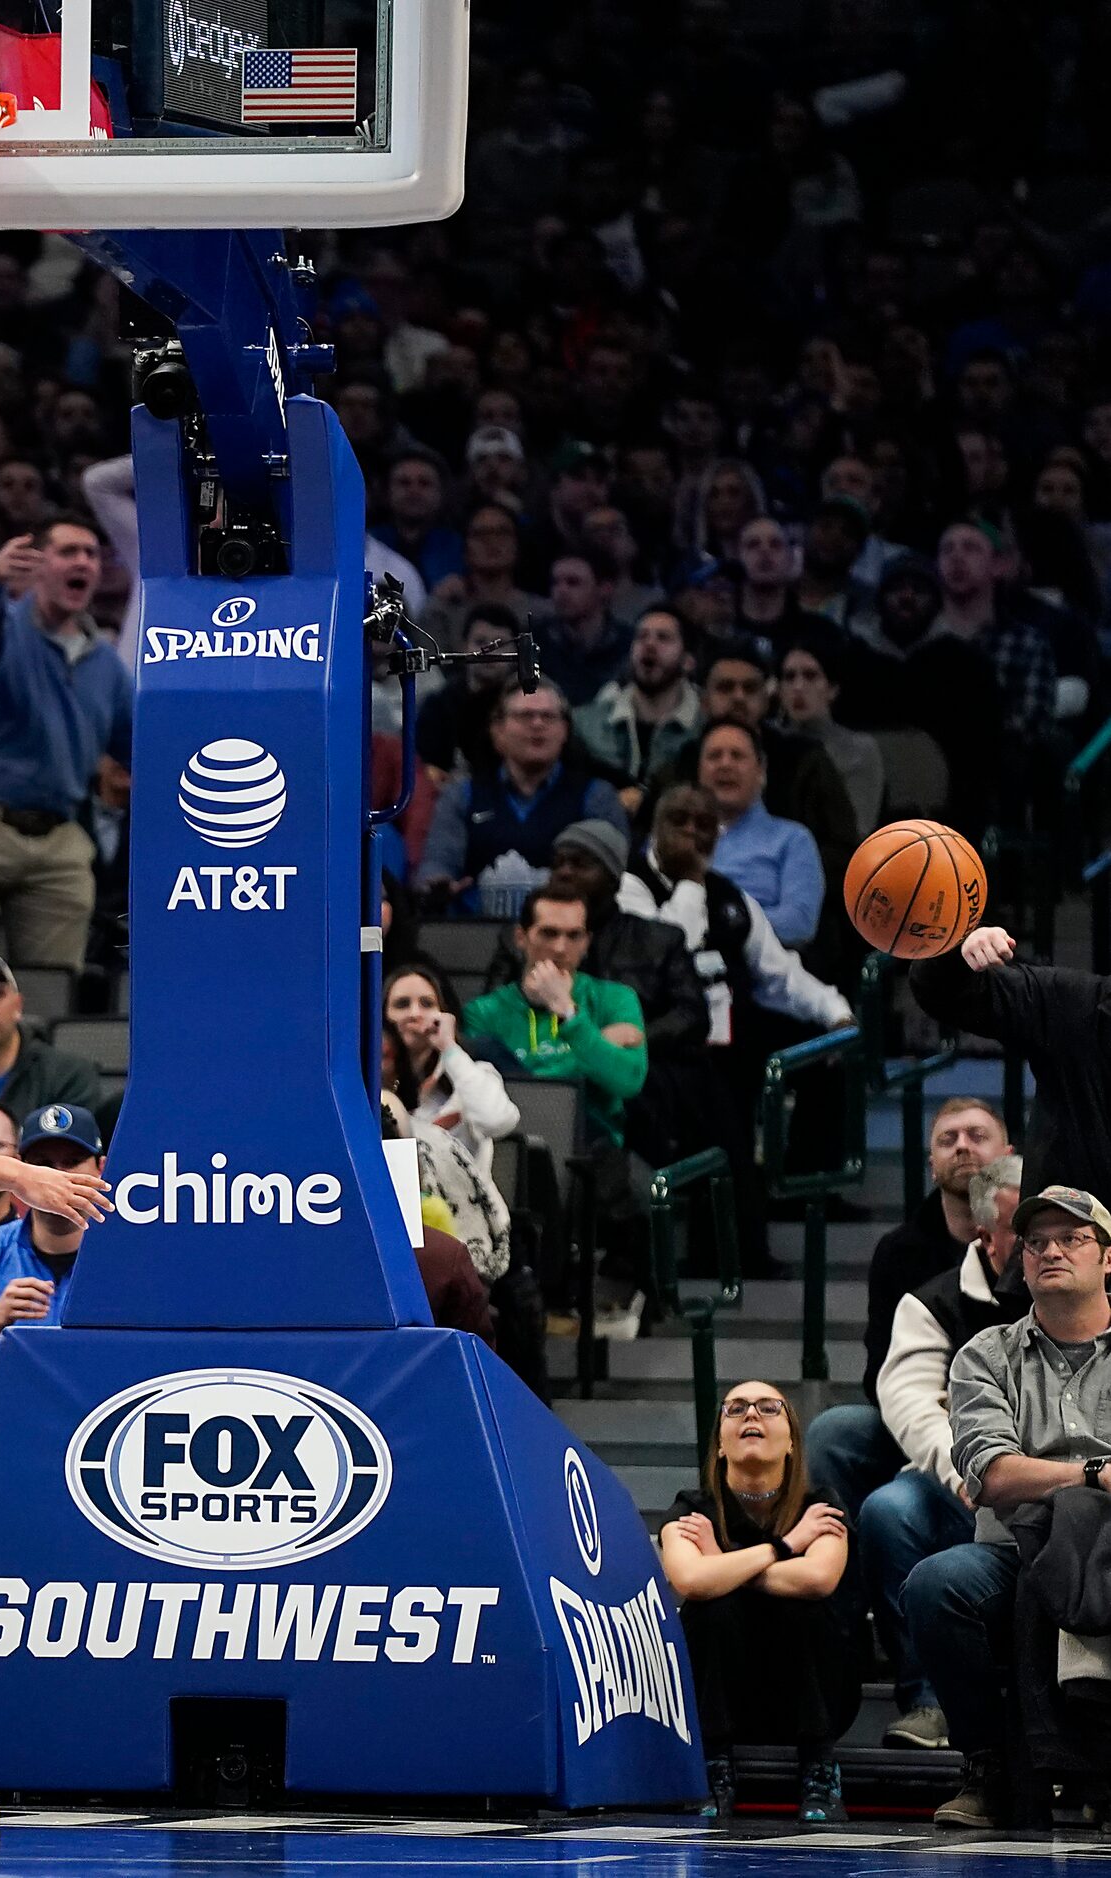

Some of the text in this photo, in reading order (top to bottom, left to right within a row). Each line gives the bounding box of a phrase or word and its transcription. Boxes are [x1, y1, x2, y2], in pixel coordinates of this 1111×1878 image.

[144, 623, 324, 664] SPALDING
[166, 866, 298, 911] AT&T
[114, 1152, 342, 1226] chime
[142, 1411, 316, 1491] FOX
[140, 1491, 318, 1524] SPORTS
[549, 1575, 692, 1747] SPALDING
